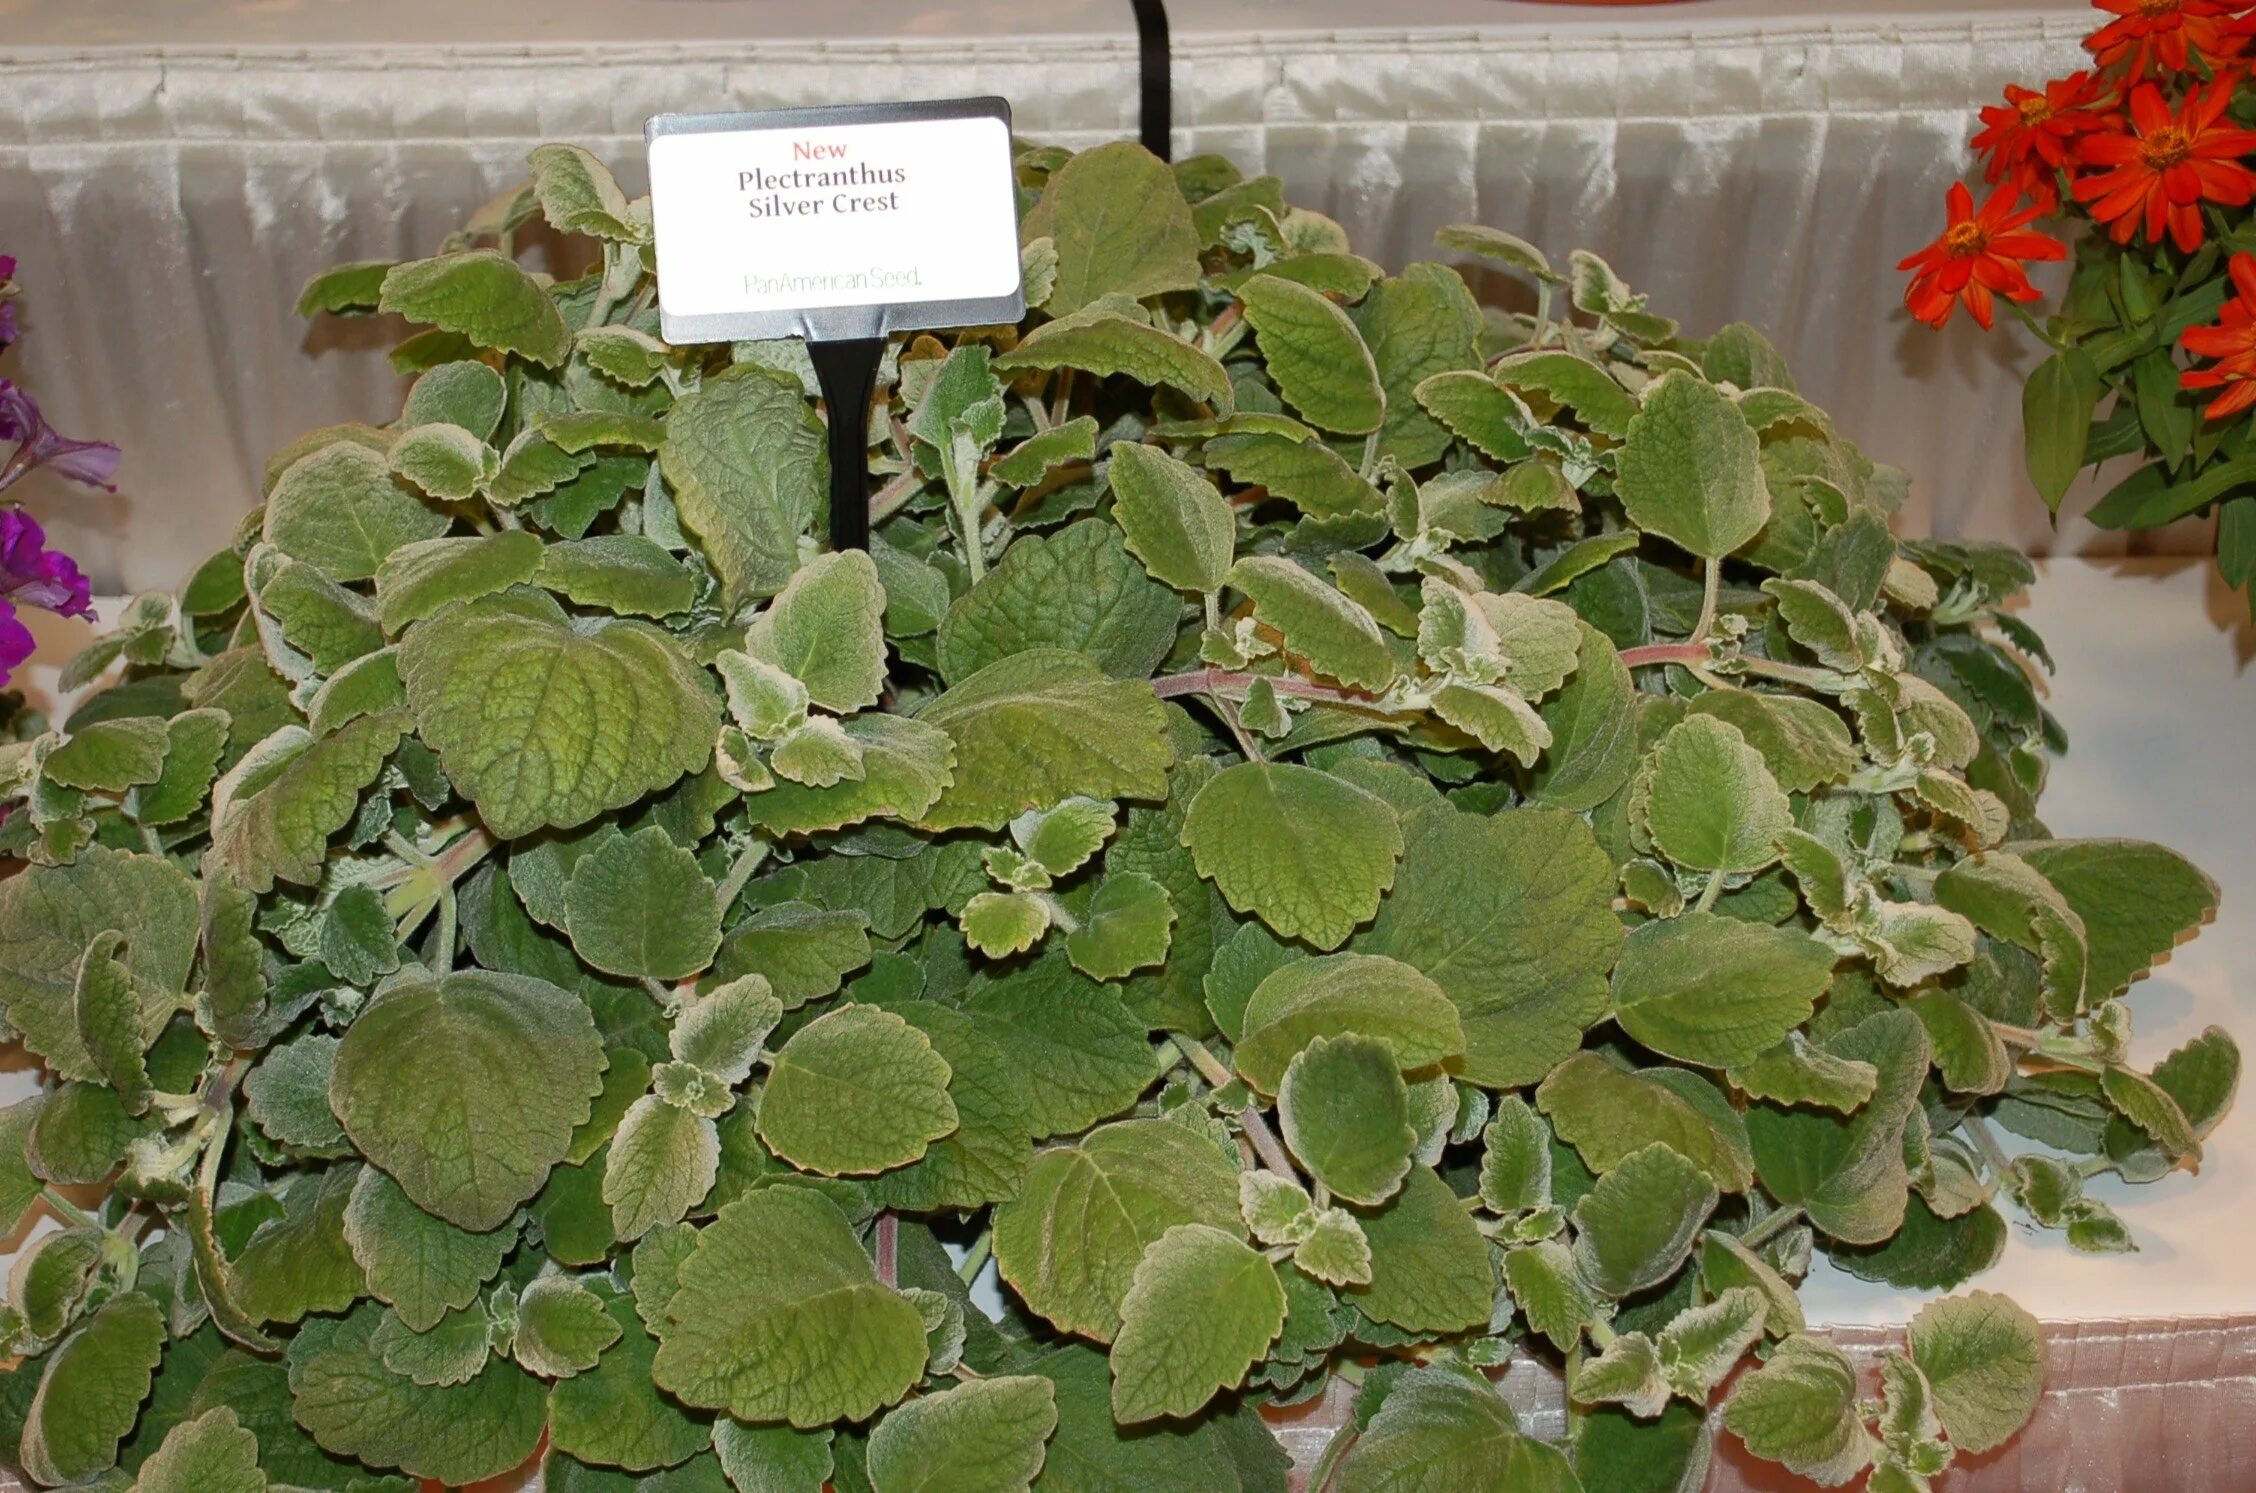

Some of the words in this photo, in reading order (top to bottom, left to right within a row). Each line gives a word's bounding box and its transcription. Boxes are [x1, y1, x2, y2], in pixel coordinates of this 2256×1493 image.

[793, 141, 847, 161] New
[739, 161, 906, 191] Plectranthus
[749, 193, 824, 218] Silver
[832, 191, 899, 213] Crest
